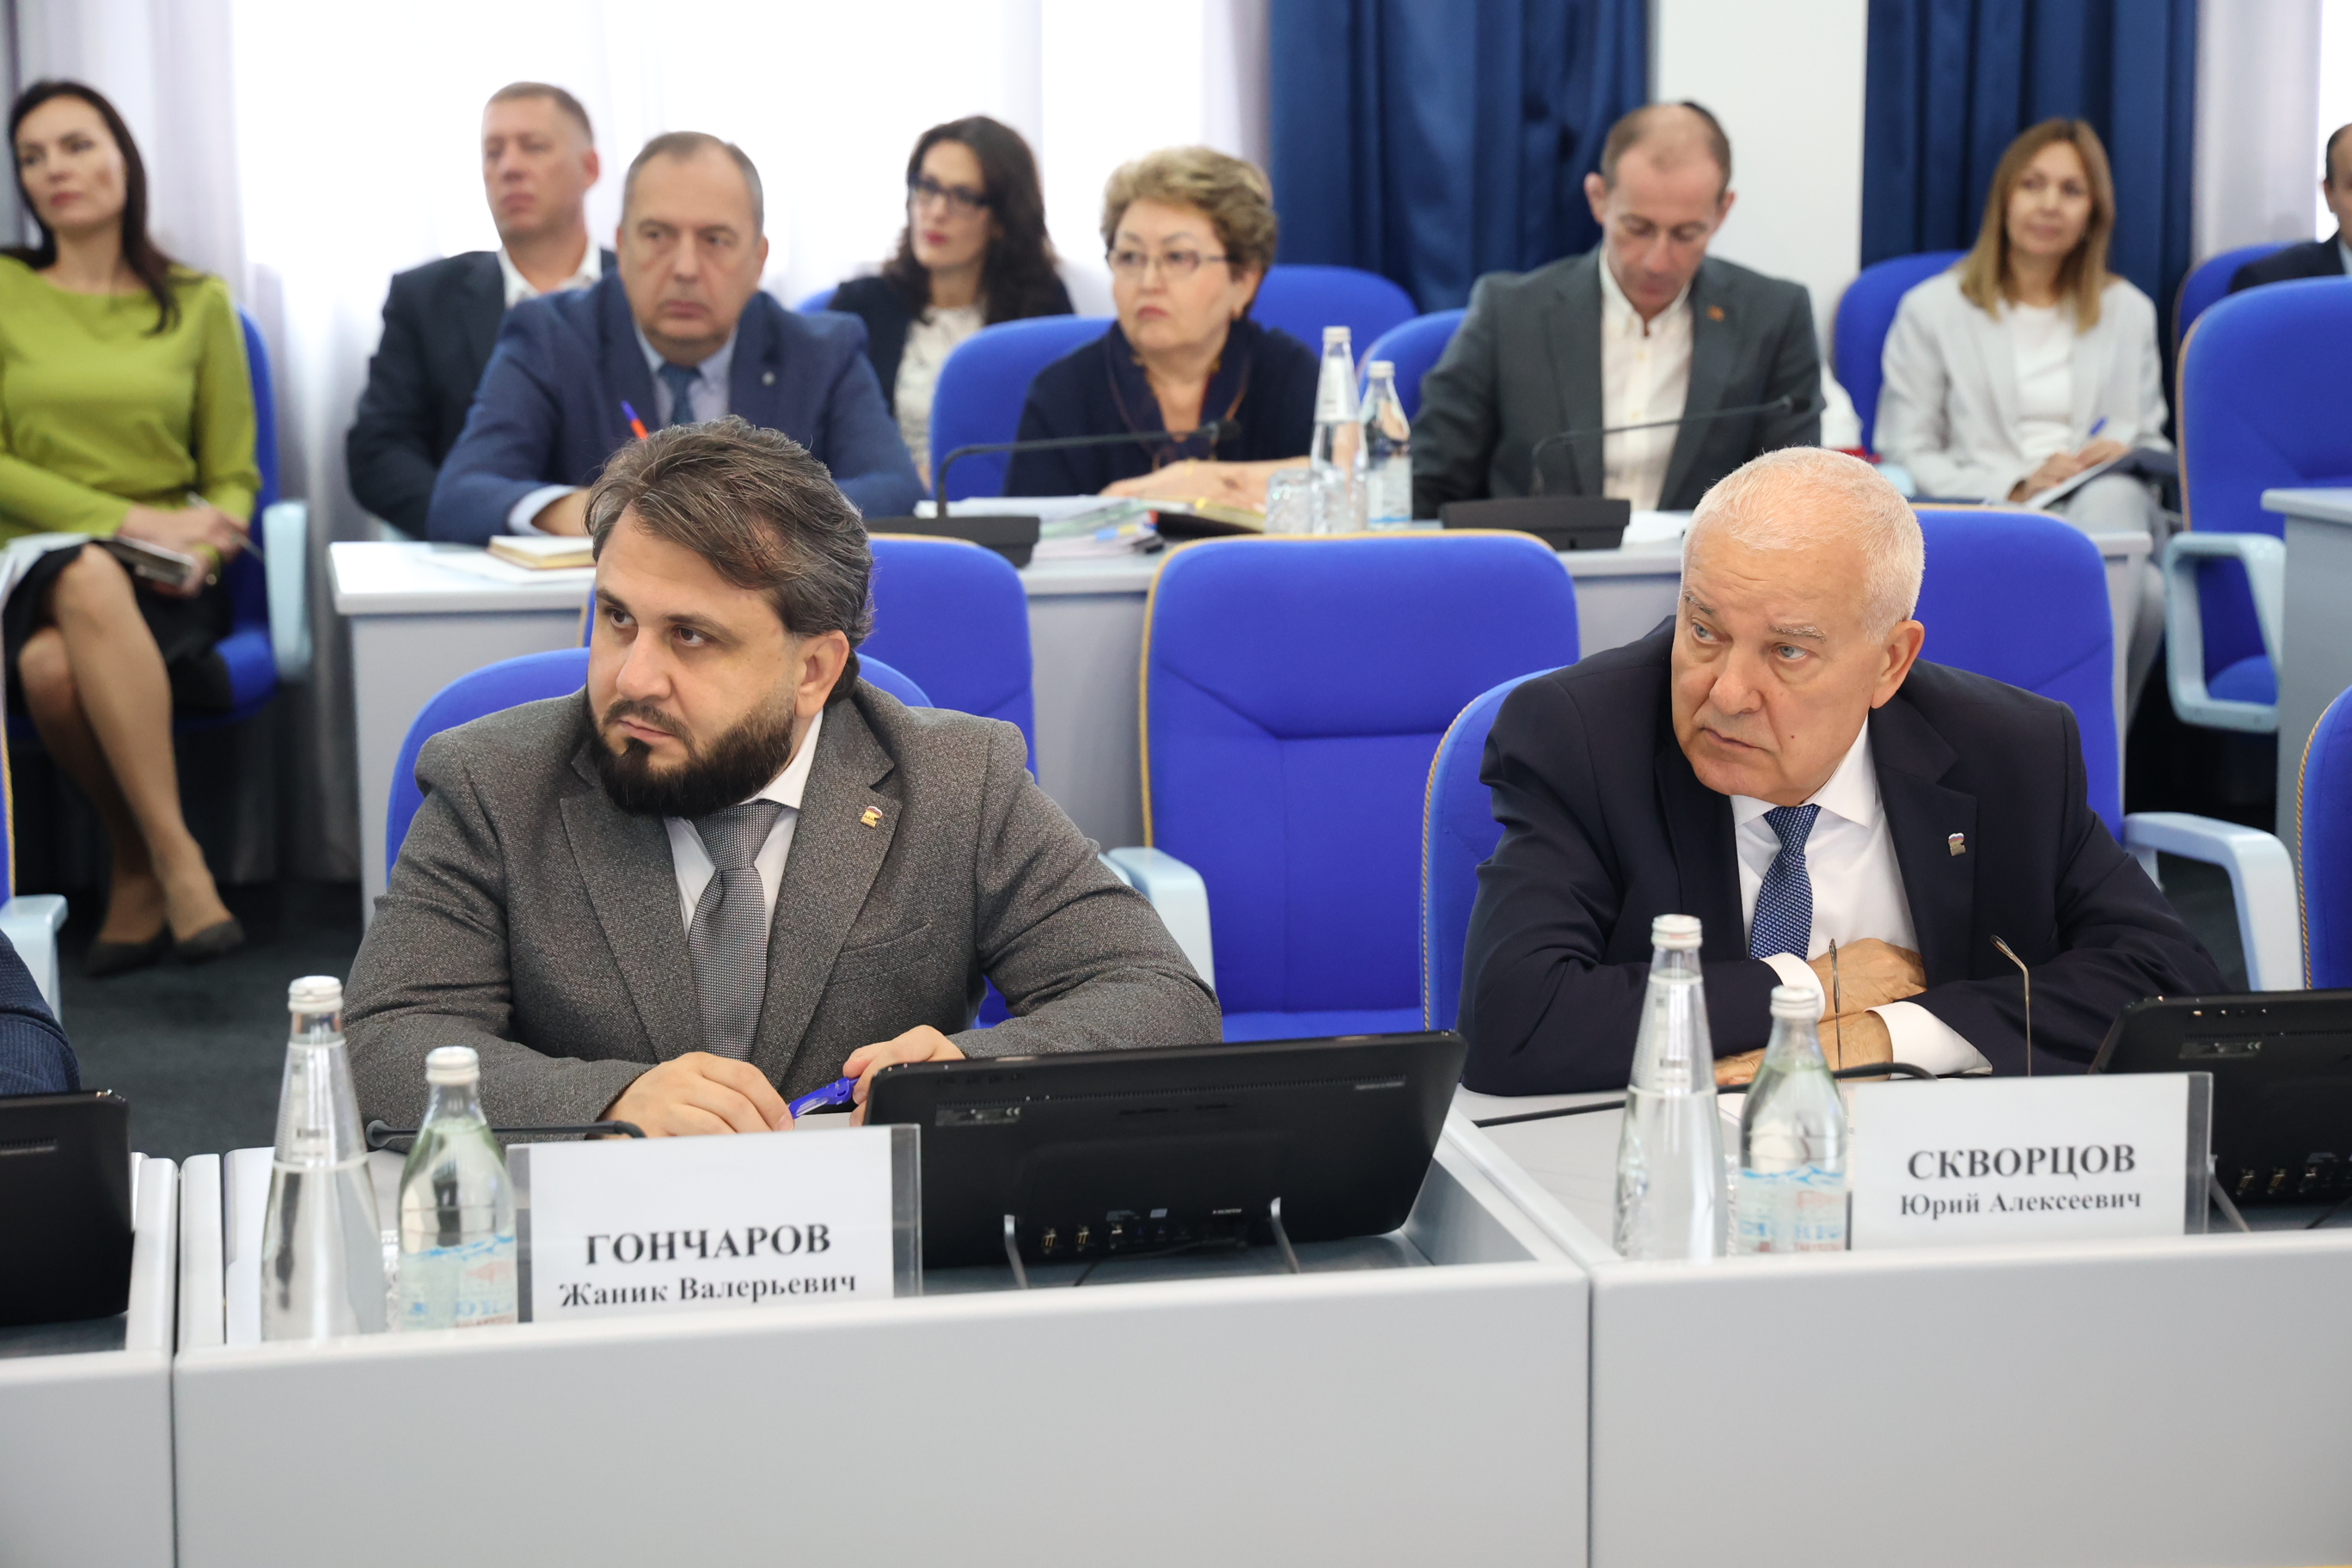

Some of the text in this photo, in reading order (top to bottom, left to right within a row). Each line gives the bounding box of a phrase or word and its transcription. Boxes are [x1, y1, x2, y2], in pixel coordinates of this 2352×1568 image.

[1908, 1144, 2136, 1180] СКВОРЦОВ
[1900, 1191, 2141, 1221] Юрий Алексеевич
[585, 1222, 831, 1266] ГОНЧАРОВ
[559, 1274, 856, 1308] Жаник Валерьевич
